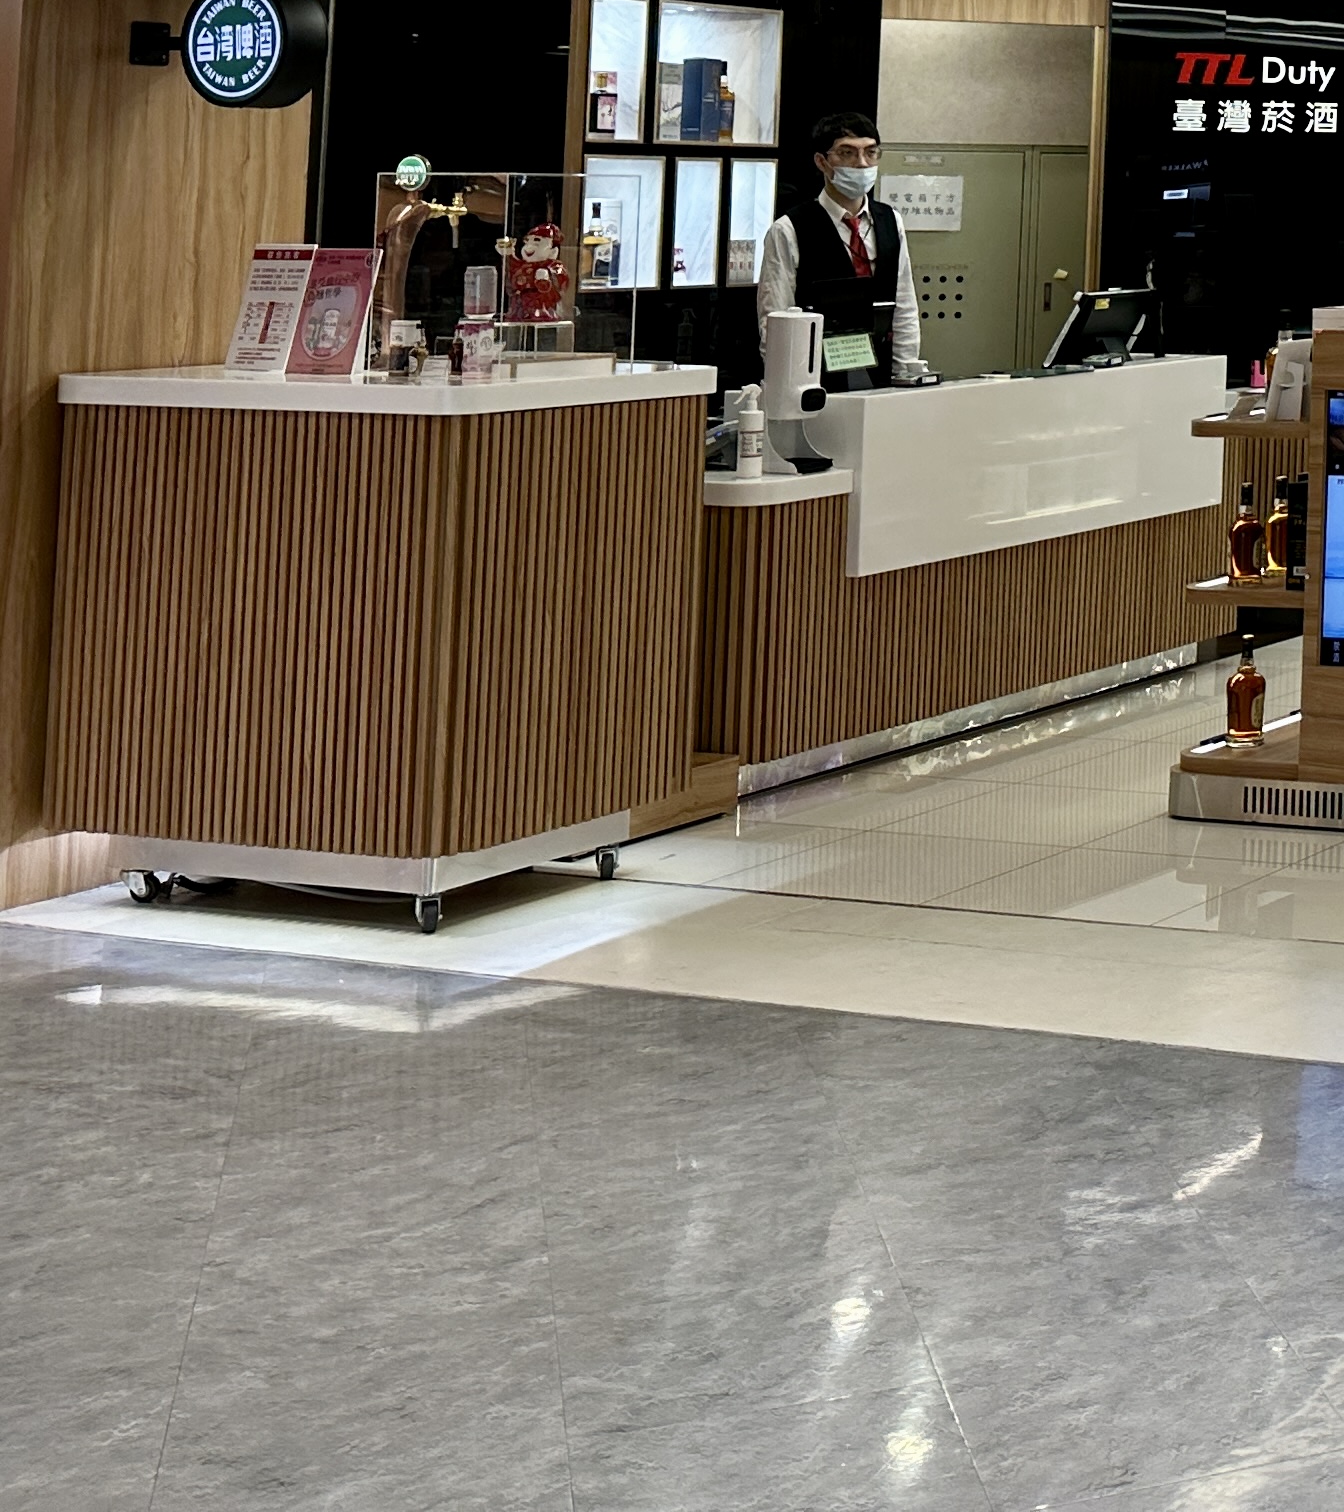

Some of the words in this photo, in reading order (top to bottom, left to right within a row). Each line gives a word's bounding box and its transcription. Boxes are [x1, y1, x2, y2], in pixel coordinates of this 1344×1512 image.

[203, 63, 236, 86] TAIWAN
[242, 59, 267, 84] BEER
[1175, 52, 1255, 85] TTL
[1262, 56, 1336, 92] Duty
